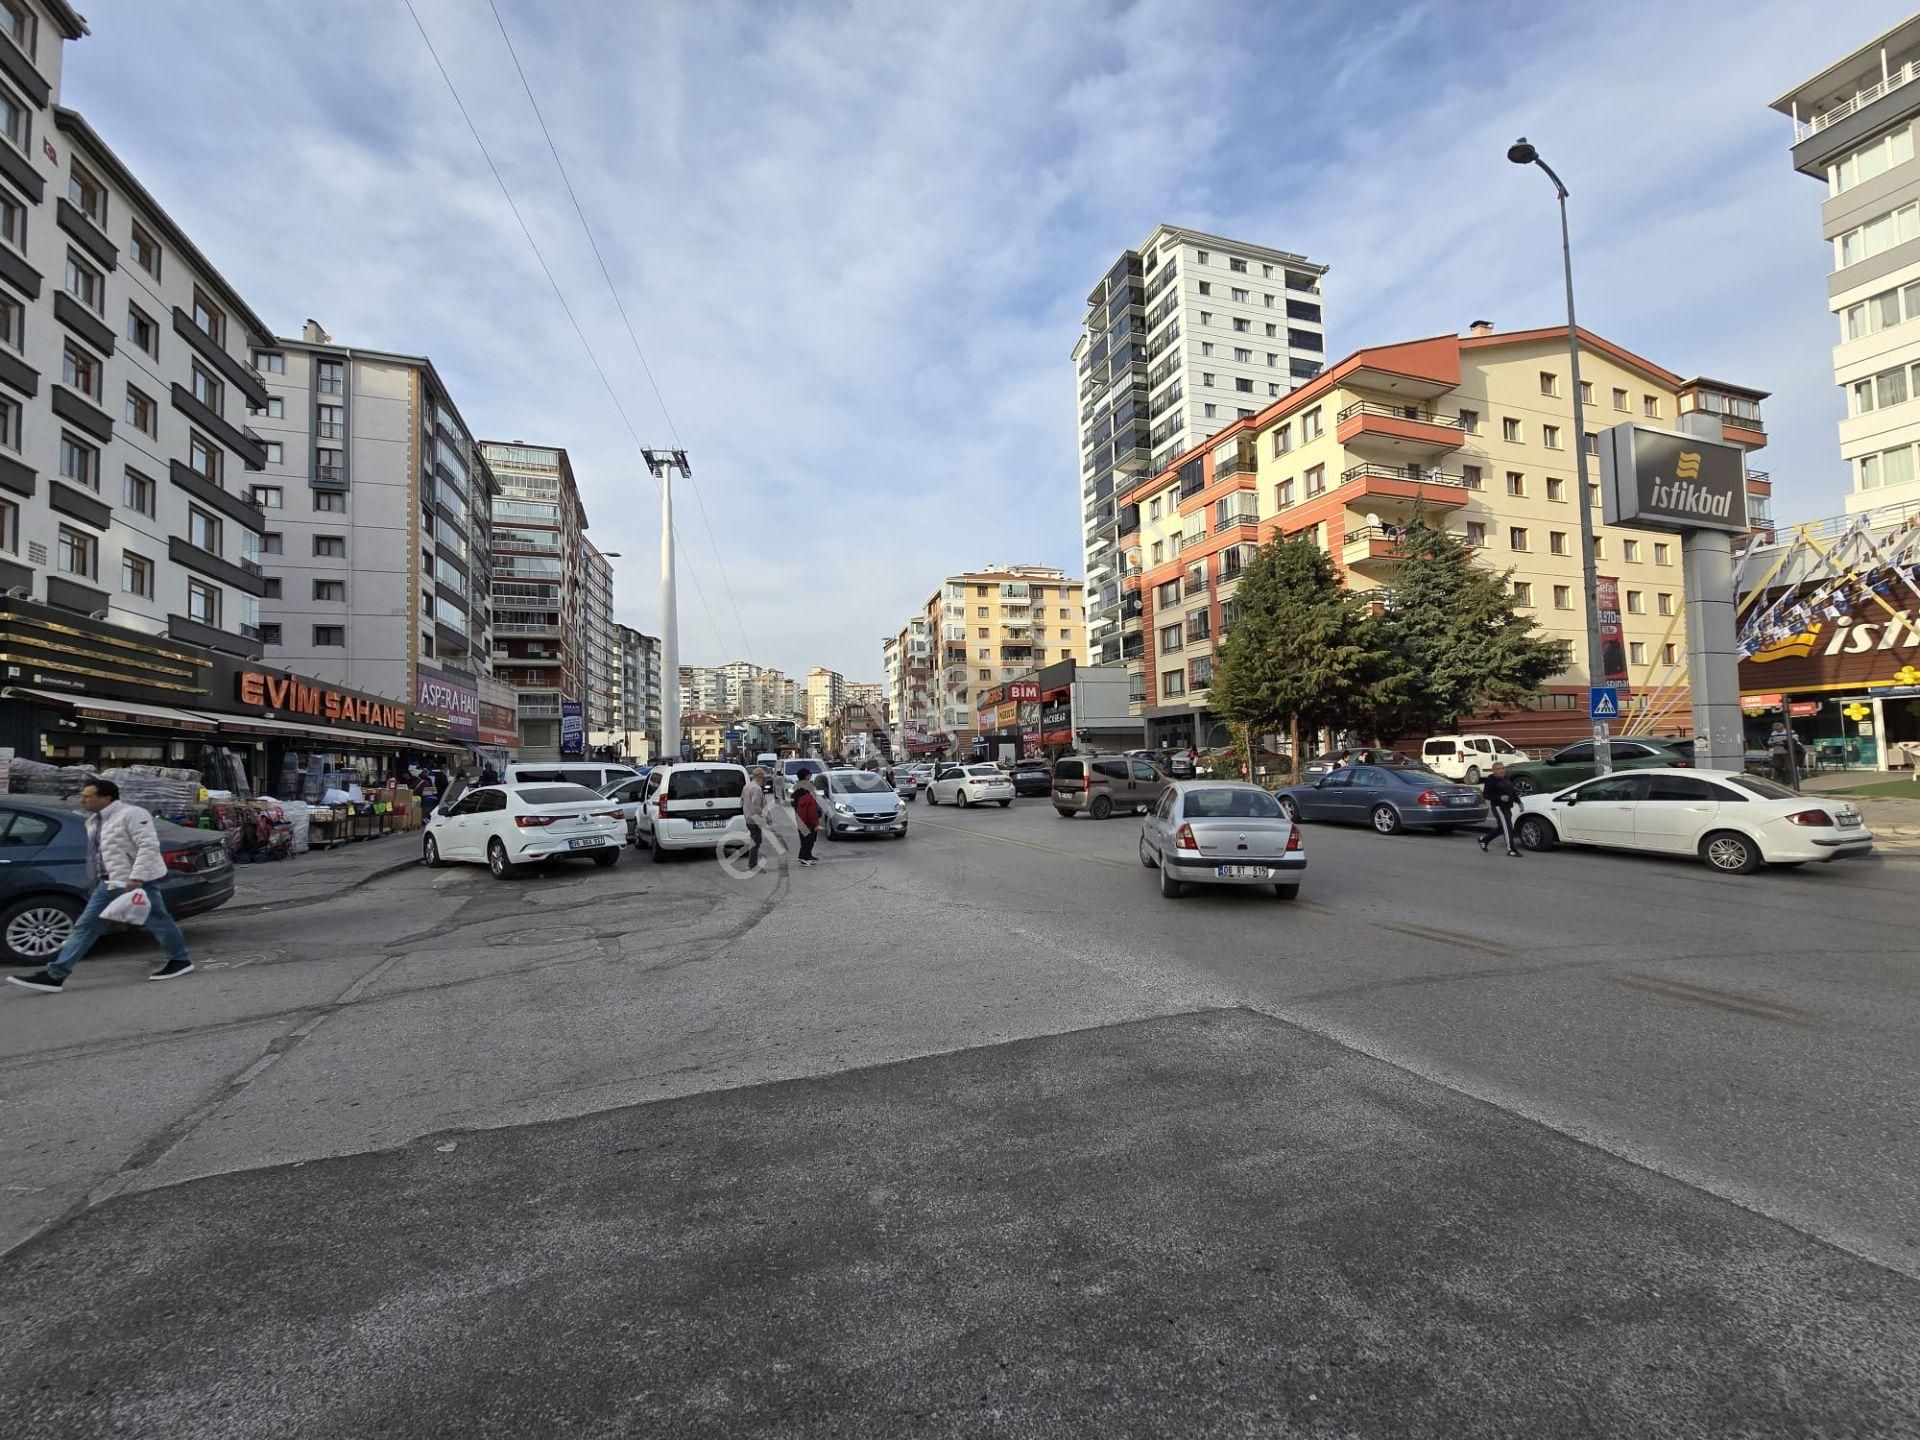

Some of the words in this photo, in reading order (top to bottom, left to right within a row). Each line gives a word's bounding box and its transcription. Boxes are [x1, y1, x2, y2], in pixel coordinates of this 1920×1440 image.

[1650, 476, 1733, 518] istikbal
[241, 671, 320, 715] EVİM
[325, 690, 406, 730] ŞAHANE
[420, 681, 459, 712] ASPERA
[1011, 684, 1037, 698] BİM
